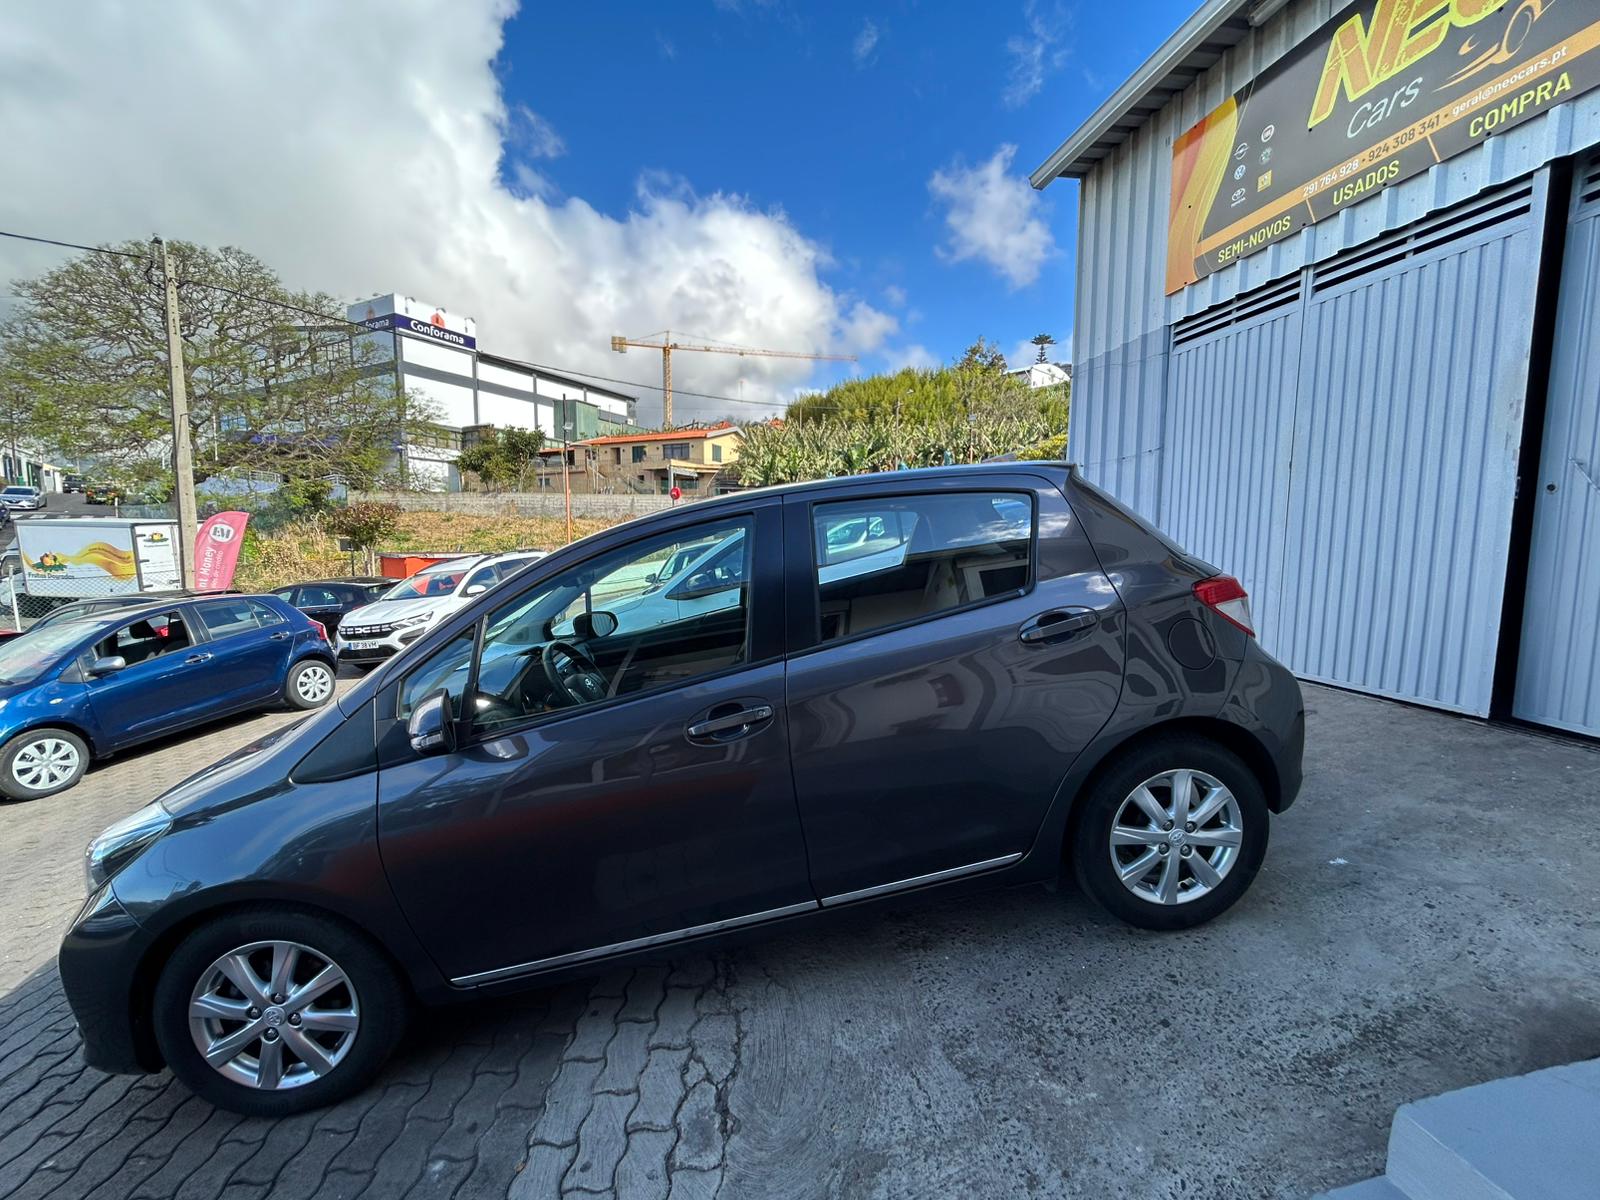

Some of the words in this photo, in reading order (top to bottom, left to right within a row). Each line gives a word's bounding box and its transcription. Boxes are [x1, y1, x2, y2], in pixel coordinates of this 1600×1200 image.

[1307, 0, 1506, 129] NE
[1303, 182, 1318, 197] 291
[1320, 172, 1337, 188] 764
[1339, 160, 1359, 177] 928
[1369, 143, 1390, 161] 924
[1392, 128, 1415, 149] 308
[1418, 113, 1440, 135] 341
[1452, 46, 1568, 117] geral@neocars.pt
[1469, 72, 1572, 137] COMPRA
[1333, 160, 1400, 205] USADOS
[1218, 215, 1291, 263] SEMI-NOVOS
[410, 320, 464, 345] Conforama
[199, 546, 217, 576] Money
